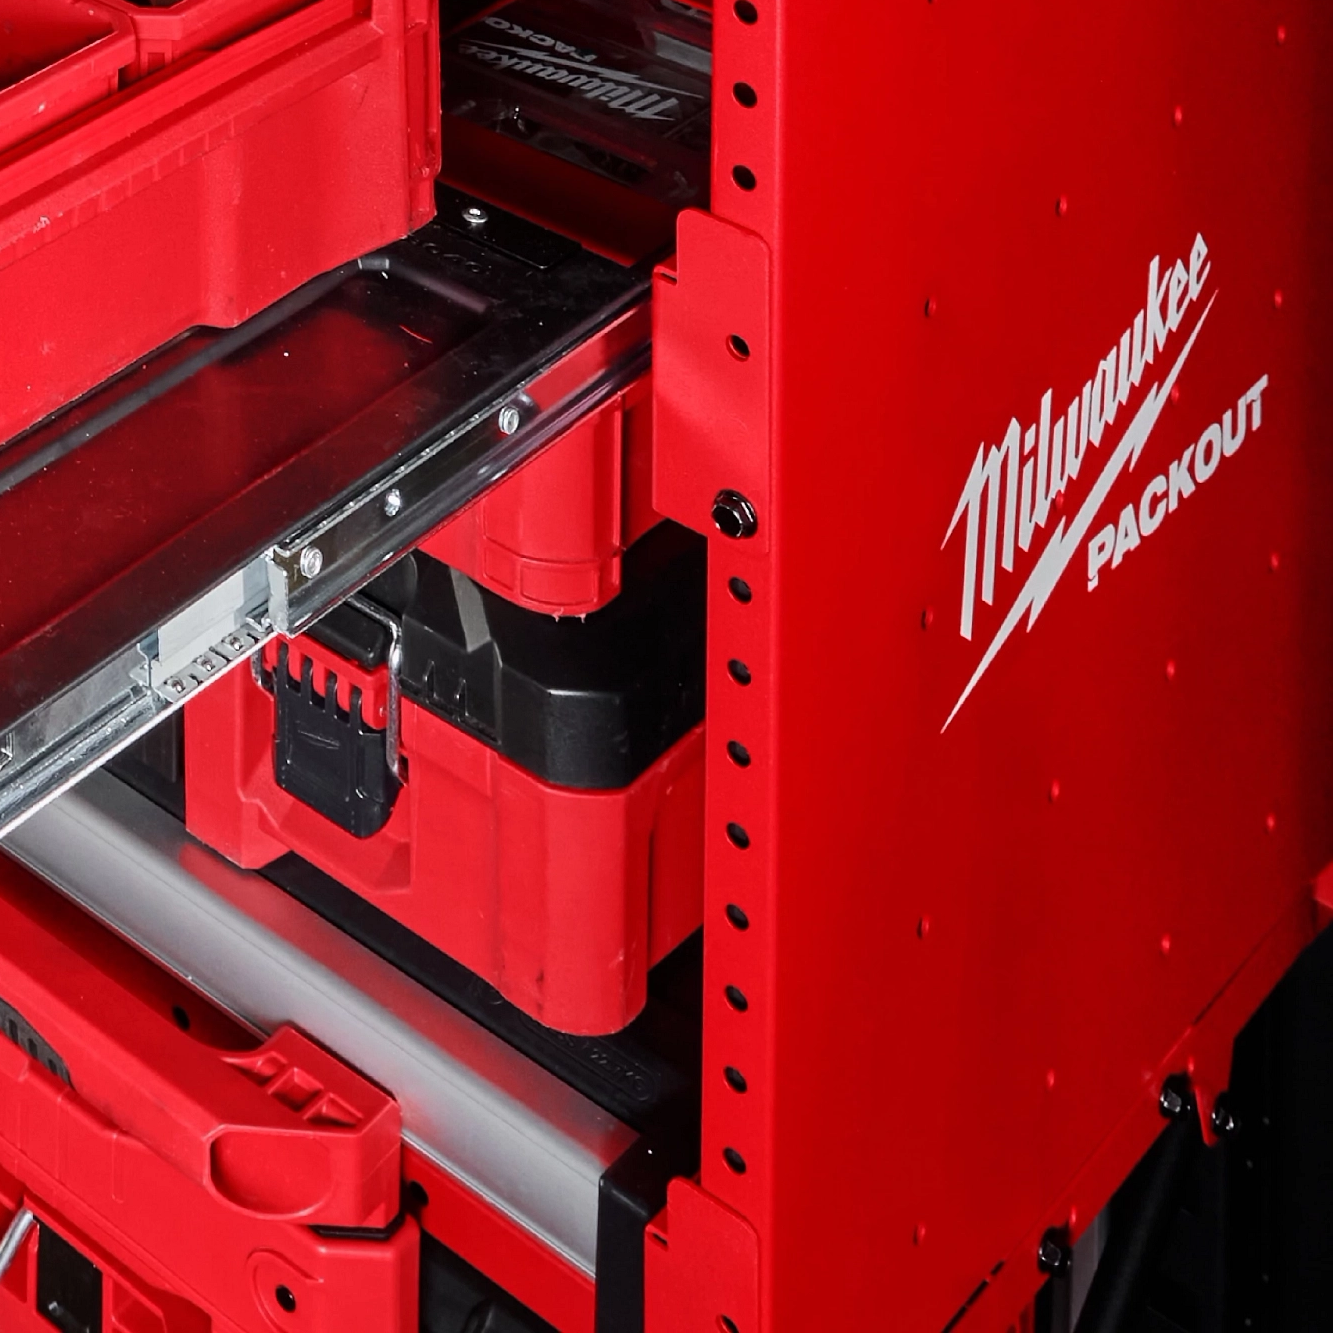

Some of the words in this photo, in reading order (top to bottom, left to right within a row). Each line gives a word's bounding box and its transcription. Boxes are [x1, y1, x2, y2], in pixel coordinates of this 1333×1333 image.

[459, 44, 678, 121] Milwaukee
[482, 16, 598, 63] PACKO
[940, 232, 1211, 641] Milwaukee
[1087, 374, 1269, 593] PACKOUT
